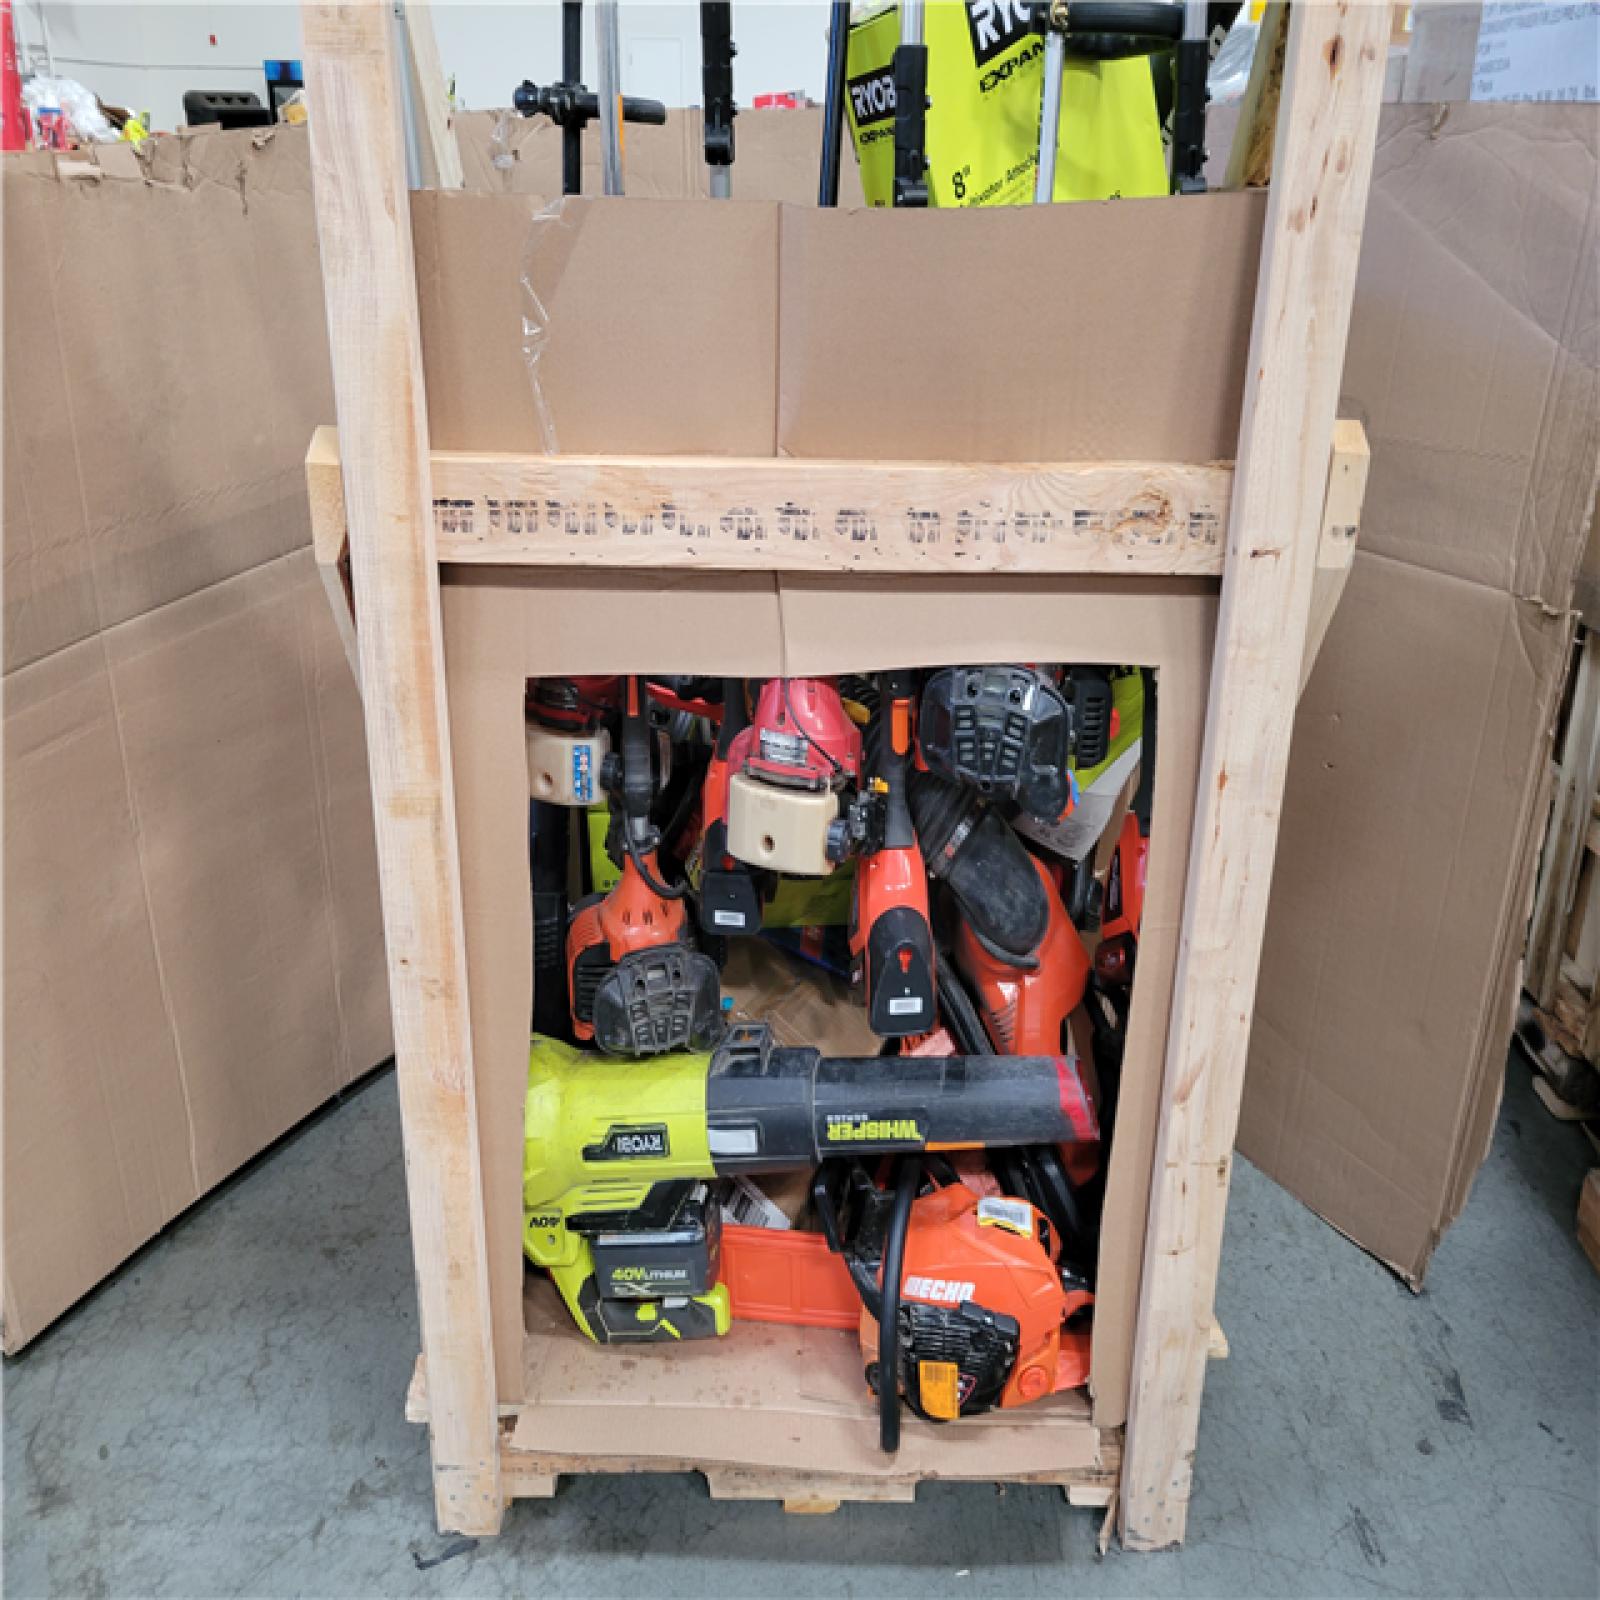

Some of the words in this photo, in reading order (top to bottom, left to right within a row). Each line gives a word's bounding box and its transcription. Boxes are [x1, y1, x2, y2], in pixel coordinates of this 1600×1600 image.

[827, 1119, 924, 1141] WHISPER
[617, 1134, 664, 1153] RYOBI
[919, 1278, 976, 1303] ECHO
